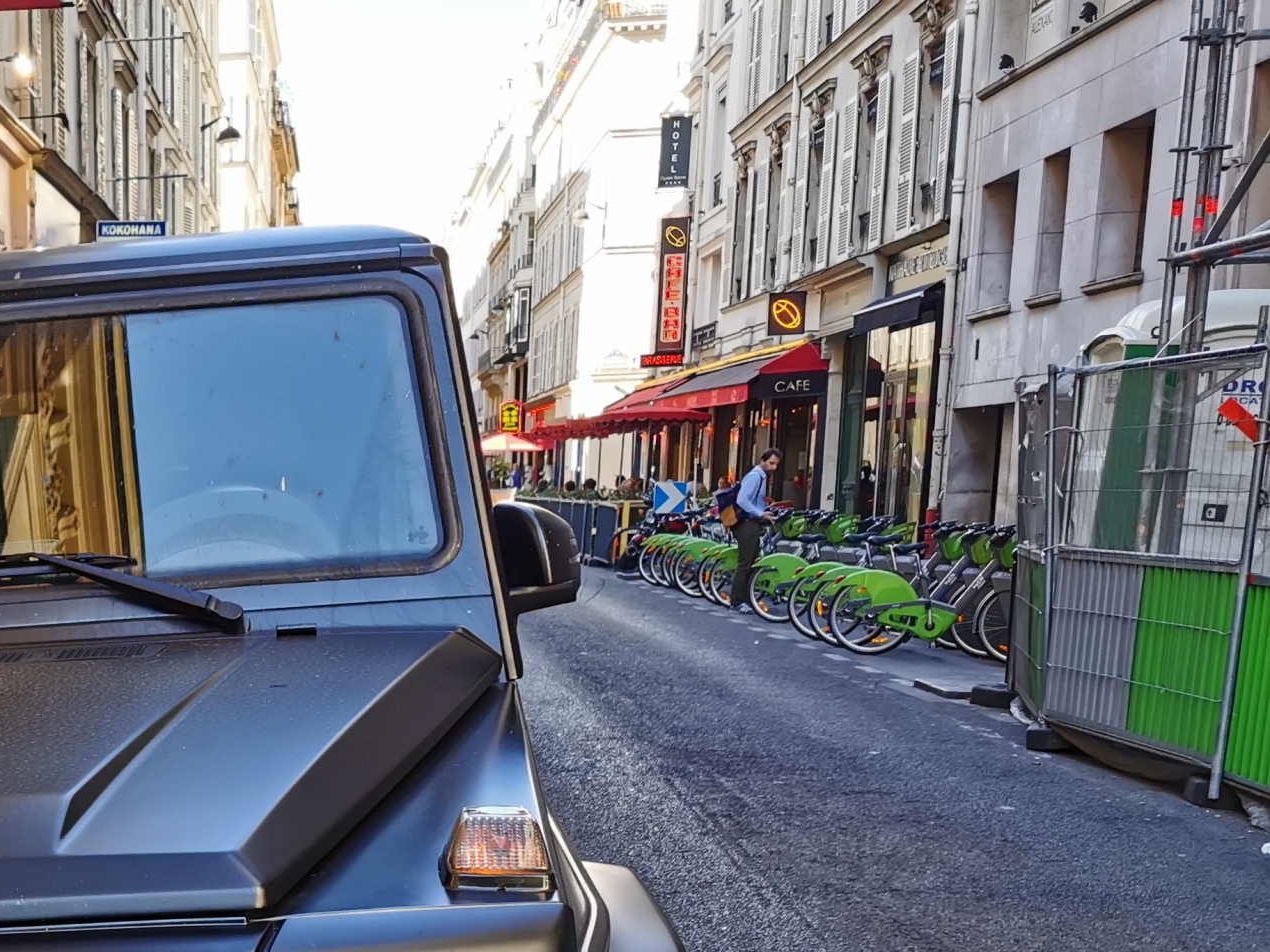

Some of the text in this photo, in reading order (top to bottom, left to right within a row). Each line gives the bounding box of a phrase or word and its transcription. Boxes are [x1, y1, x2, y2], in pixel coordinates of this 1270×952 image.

[670, 120, 681, 174] HOTEL
[101, 224, 162, 236] KOKOHANA
[641, 354, 683, 366] BRASSERIE
[774, 379, 811, 393] CAFE
